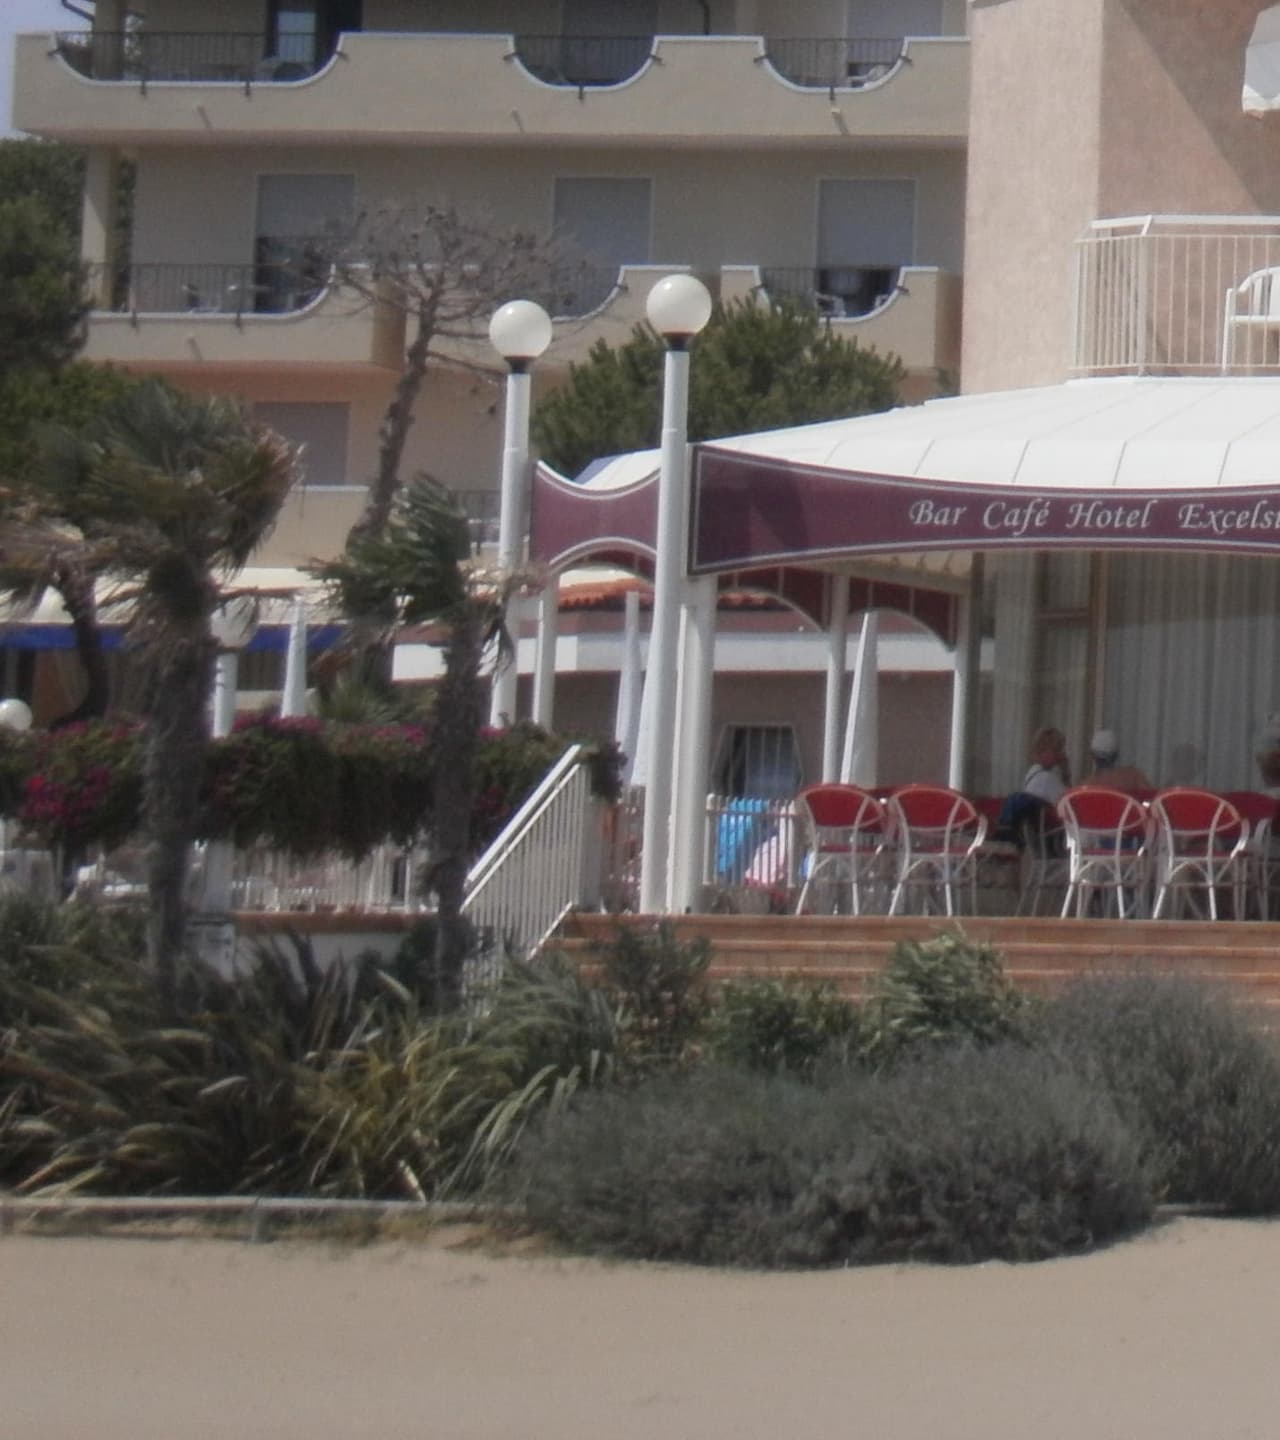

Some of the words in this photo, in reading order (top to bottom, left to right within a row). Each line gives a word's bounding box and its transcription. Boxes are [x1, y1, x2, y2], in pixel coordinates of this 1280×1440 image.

[909, 499, 967, 526] Bar
[983, 497, 1051, 536] Café
[1065, 499, 1158, 529] Hotel
